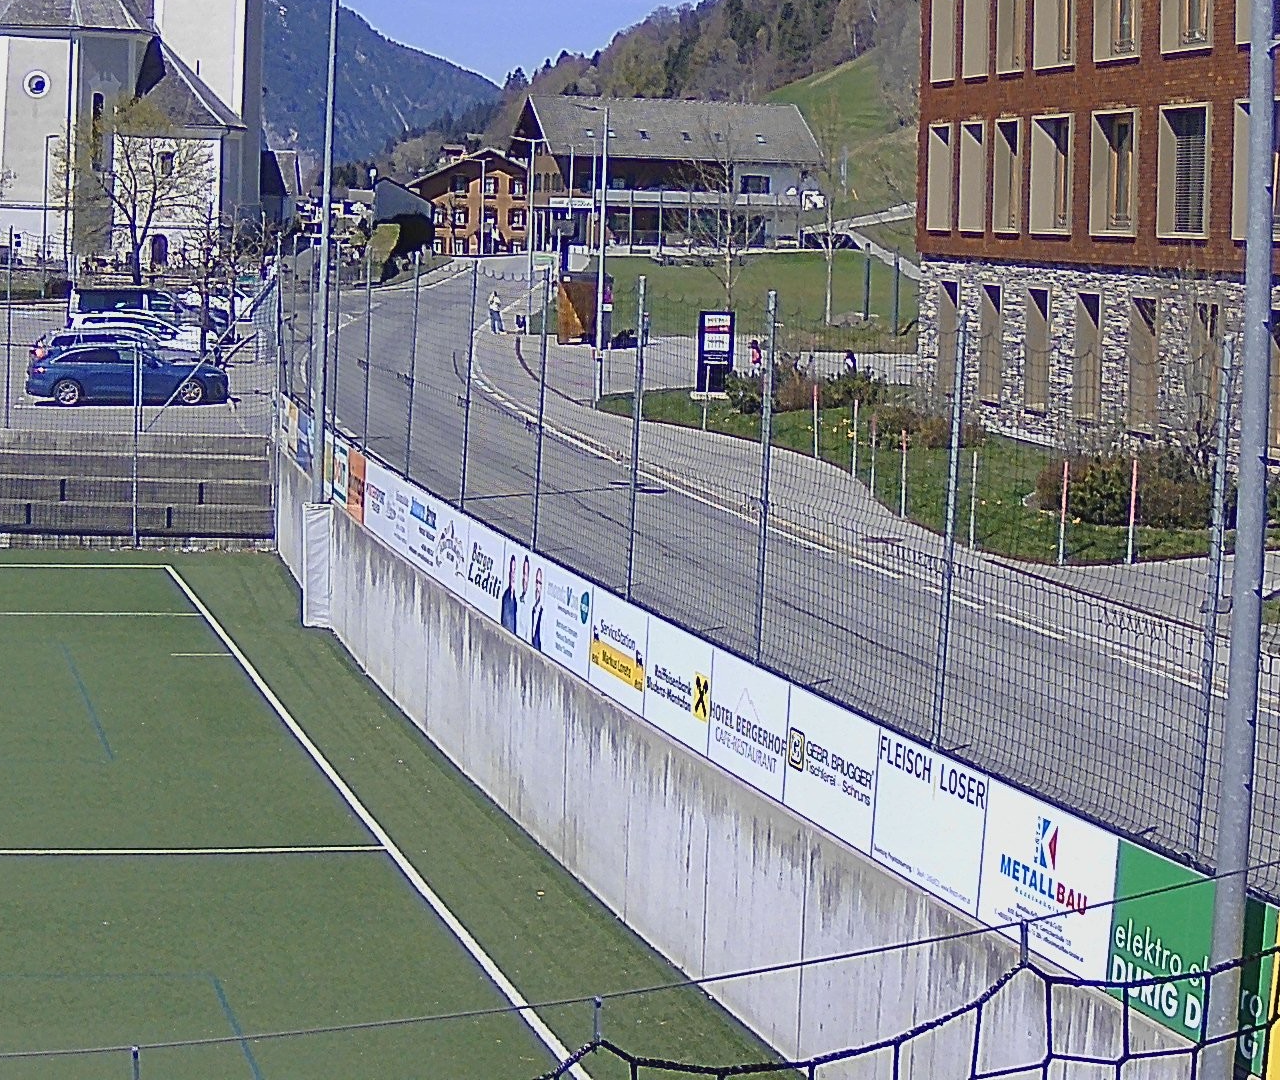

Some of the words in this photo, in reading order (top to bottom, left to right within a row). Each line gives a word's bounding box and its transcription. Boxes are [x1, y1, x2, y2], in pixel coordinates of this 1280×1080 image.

[710, 700, 734, 729] HOTEL
[735, 715, 788, 757] BERGERHOF
[879, 735, 933, 784] FLEISCH
[939, 763, 986, 810] LOSER
[1000, 853, 1088, 916] METALLBAU
[1115, 918, 1182, 977] elektro
